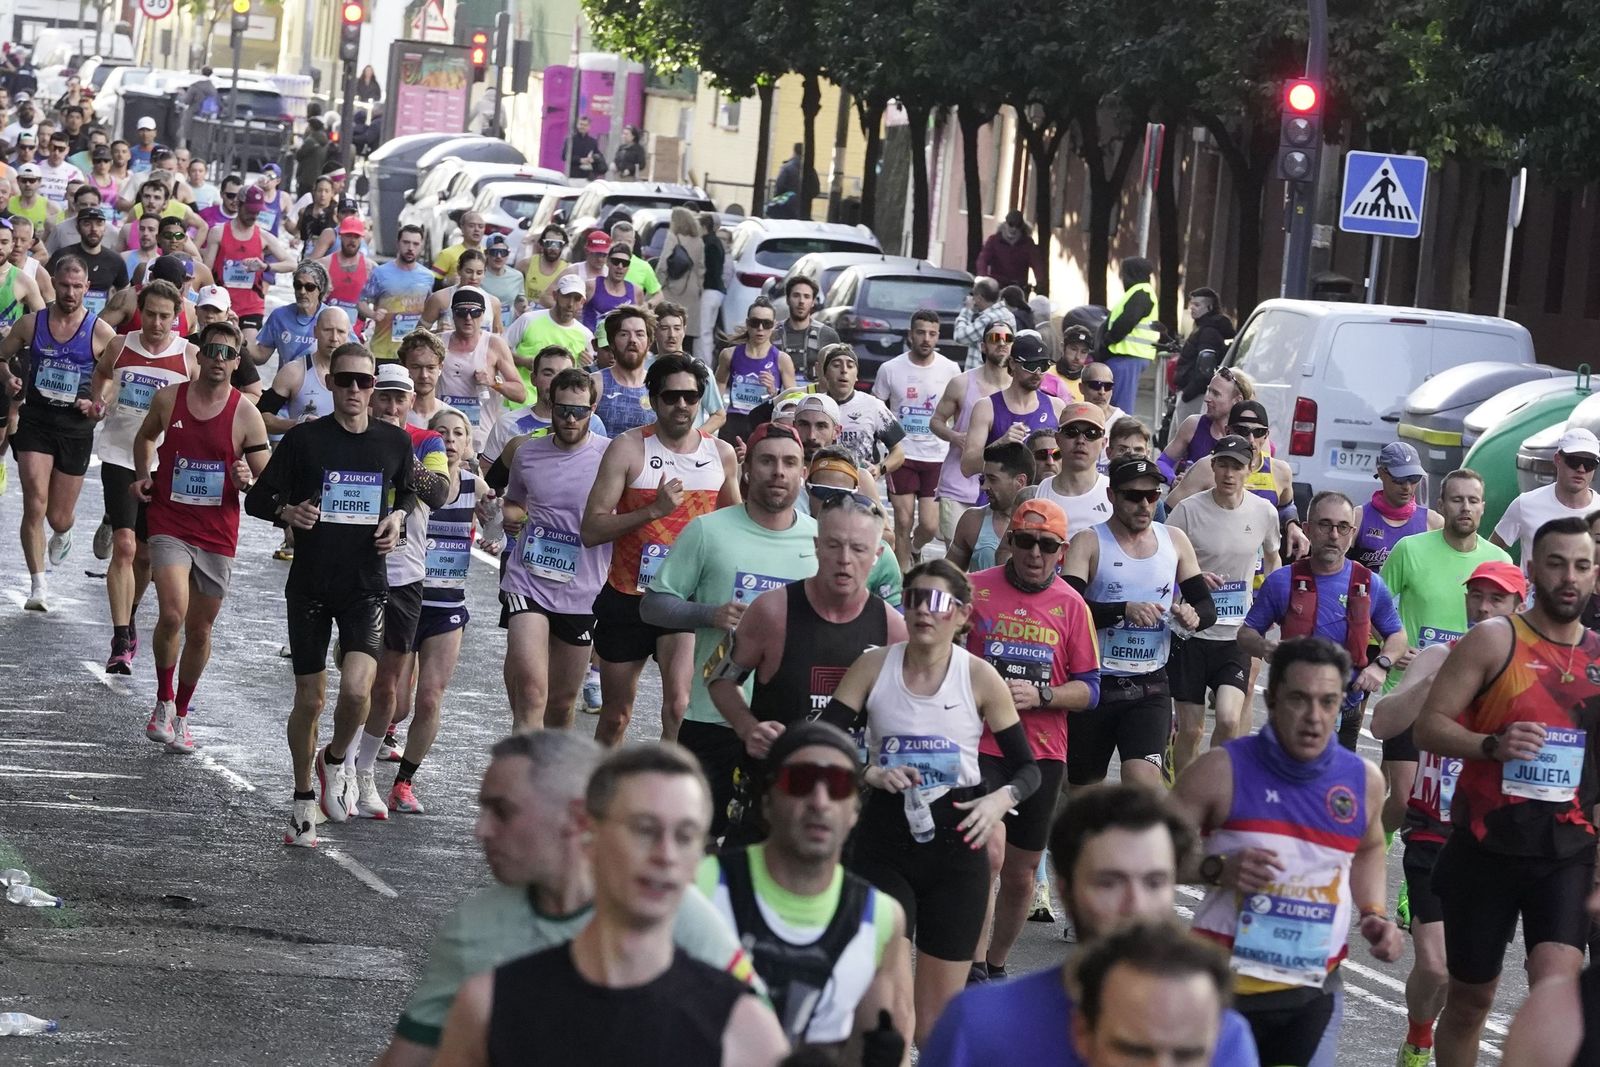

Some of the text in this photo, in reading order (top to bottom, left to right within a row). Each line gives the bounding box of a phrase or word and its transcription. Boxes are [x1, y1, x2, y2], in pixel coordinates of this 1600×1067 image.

[53, 361, 77, 371] ZURICH
[39, 378, 73, 392] ARNAUD
[903, 424, 930, 434] TORRES
[1339, 452, 1372, 467] 9177
[190, 462, 220, 471] ZURICH
[343, 474, 376, 483] ZURICH
[185, 484, 208, 495] LUIS
[343, 489, 361, 498] 9032
[331, 499, 371, 512] PIERRE
[546, 530, 577, 543] ZURICH
[439, 542, 467, 550] ZURICH
[543, 545, 561, 555] 6491
[523, 551, 577, 573] ALBEROLA
[977, 616, 1060, 646] MADRID
[1127, 636, 1146, 646] 6615
[1007, 646, 1047, 659] ZURICH
[1111, 645, 1156, 660] GERMAN
[1006, 664, 1027, 675] 4881
[904, 740, 951, 750] ZURICH
[1514, 765, 1571, 785] JULIETA
[1272, 926, 1303, 943] 6577
